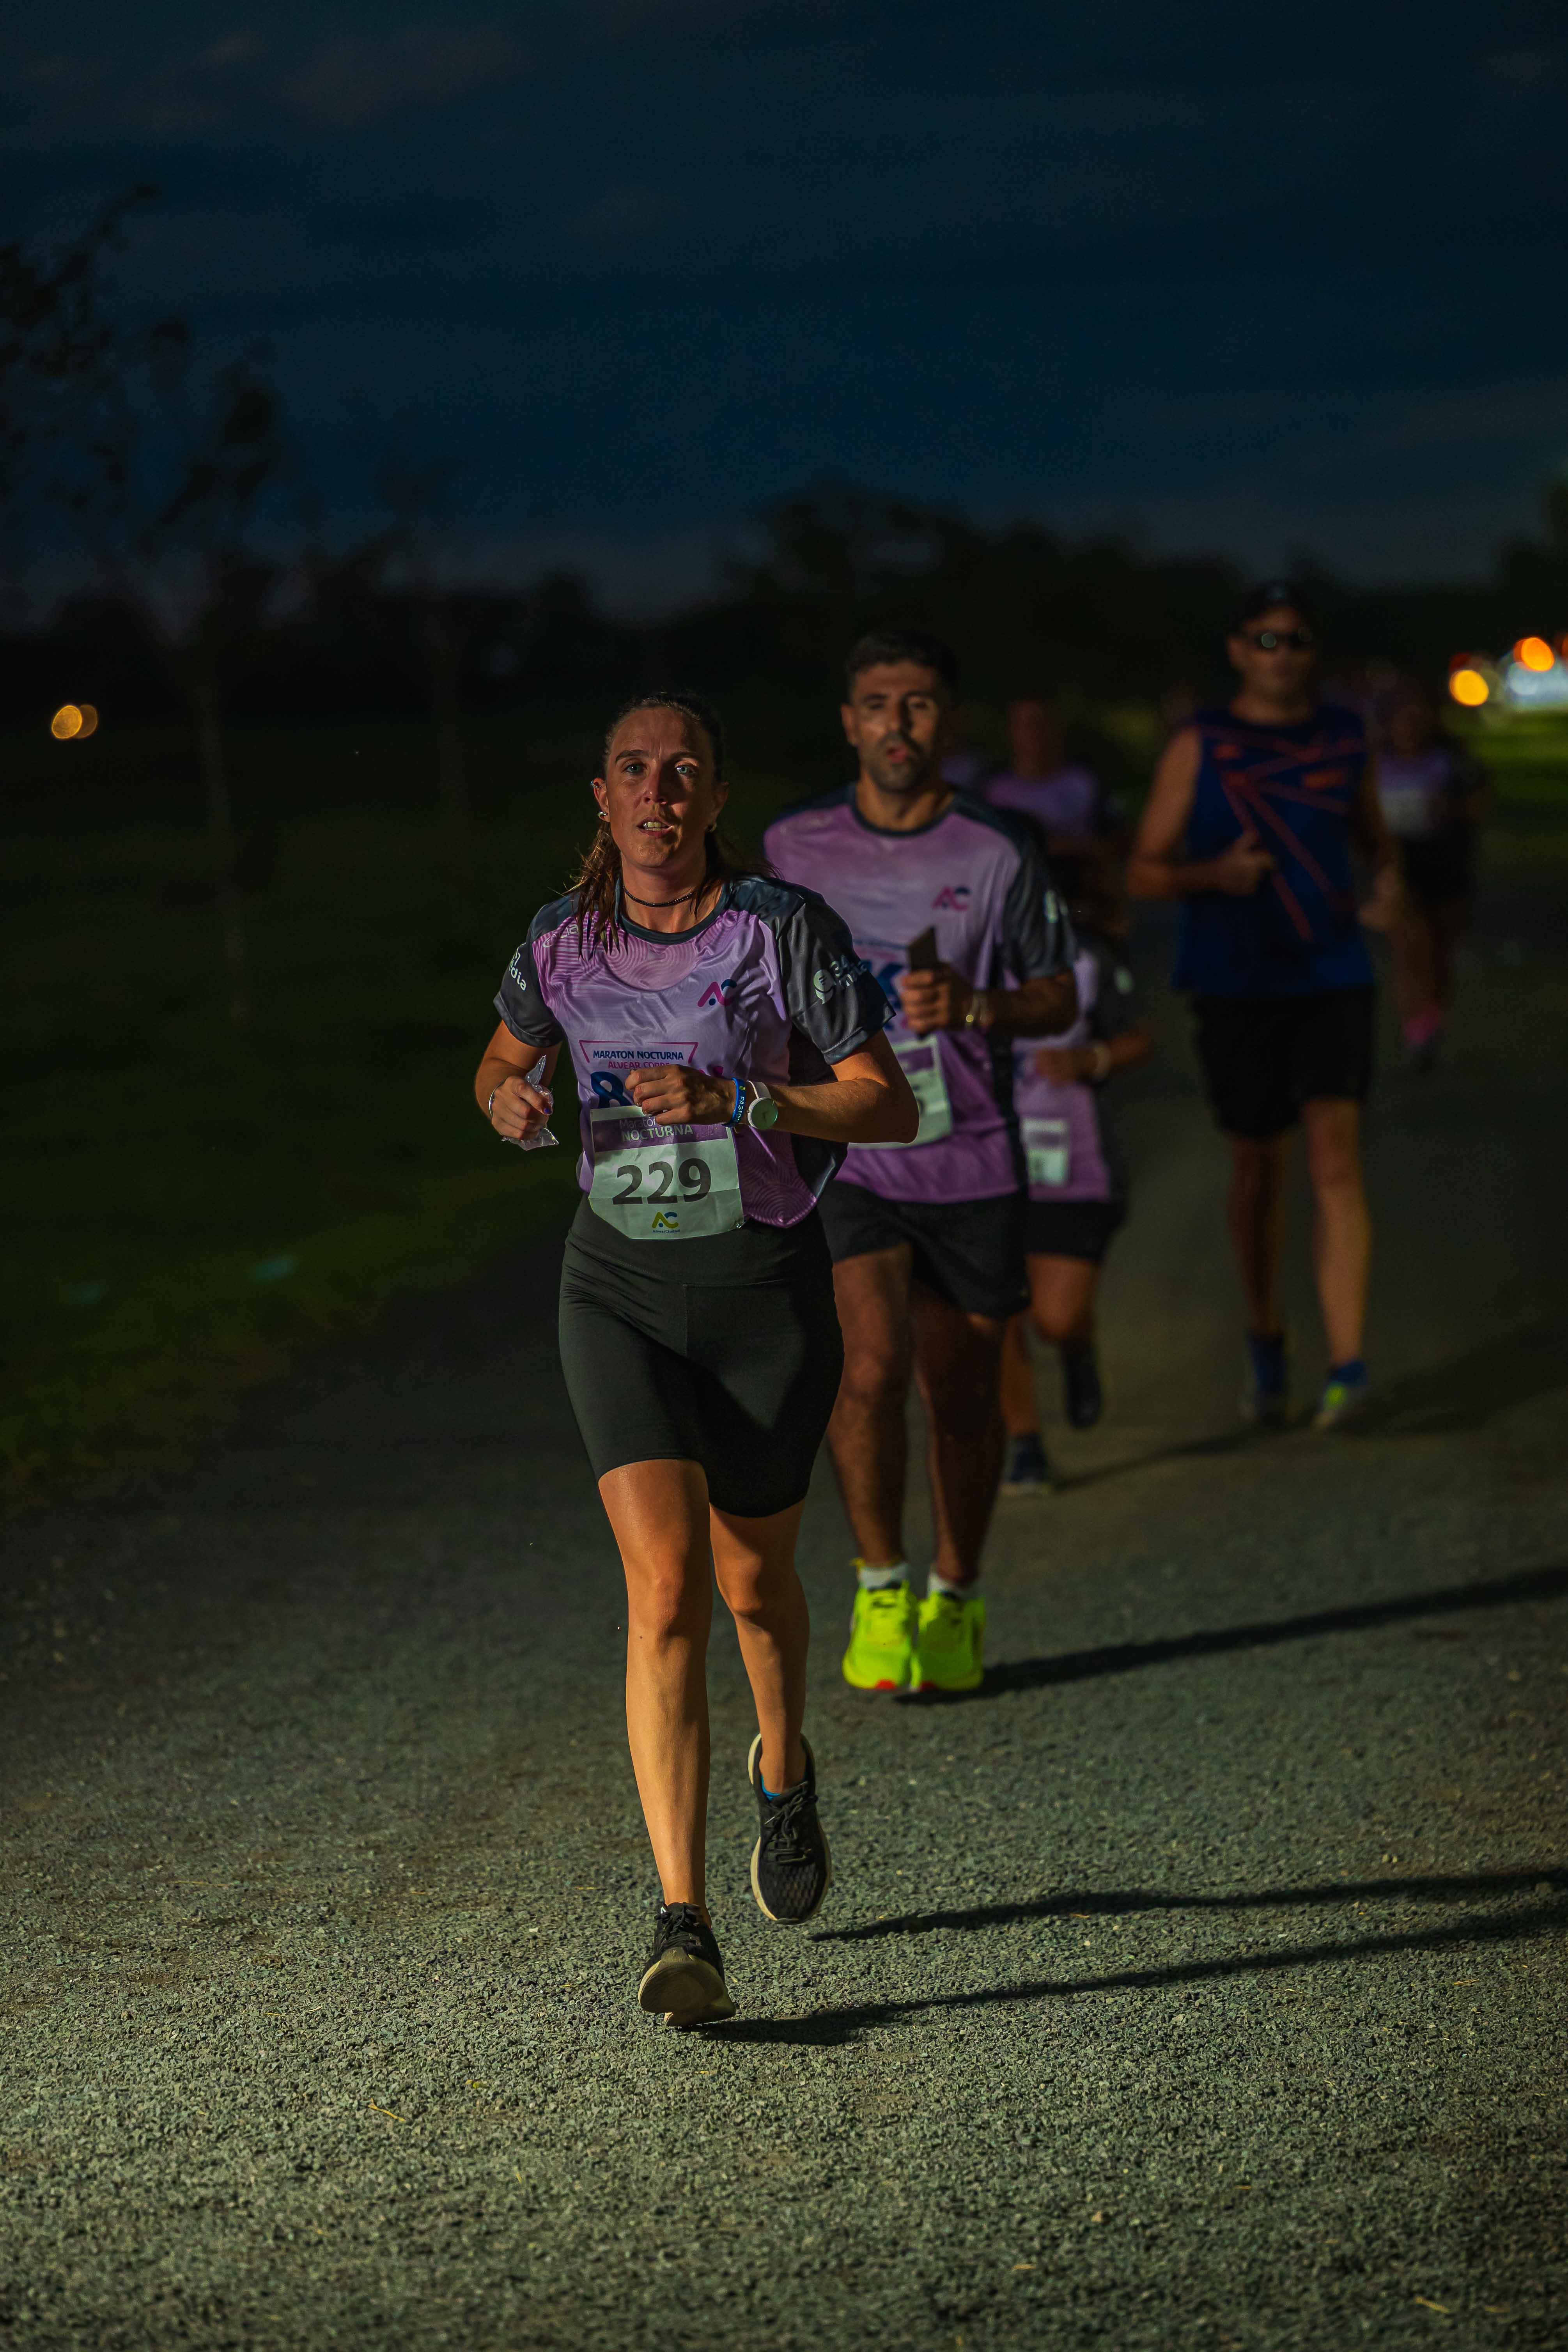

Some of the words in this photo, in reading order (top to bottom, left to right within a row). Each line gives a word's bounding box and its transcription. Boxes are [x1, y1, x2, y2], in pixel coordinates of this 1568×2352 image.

[593, 1050, 634, 1059] MARATON
[637, 1052, 684, 1060] NOCTURNA
[621, 1124, 693, 1142] NOCTURNA
[612, 1158, 712, 1205] 229
